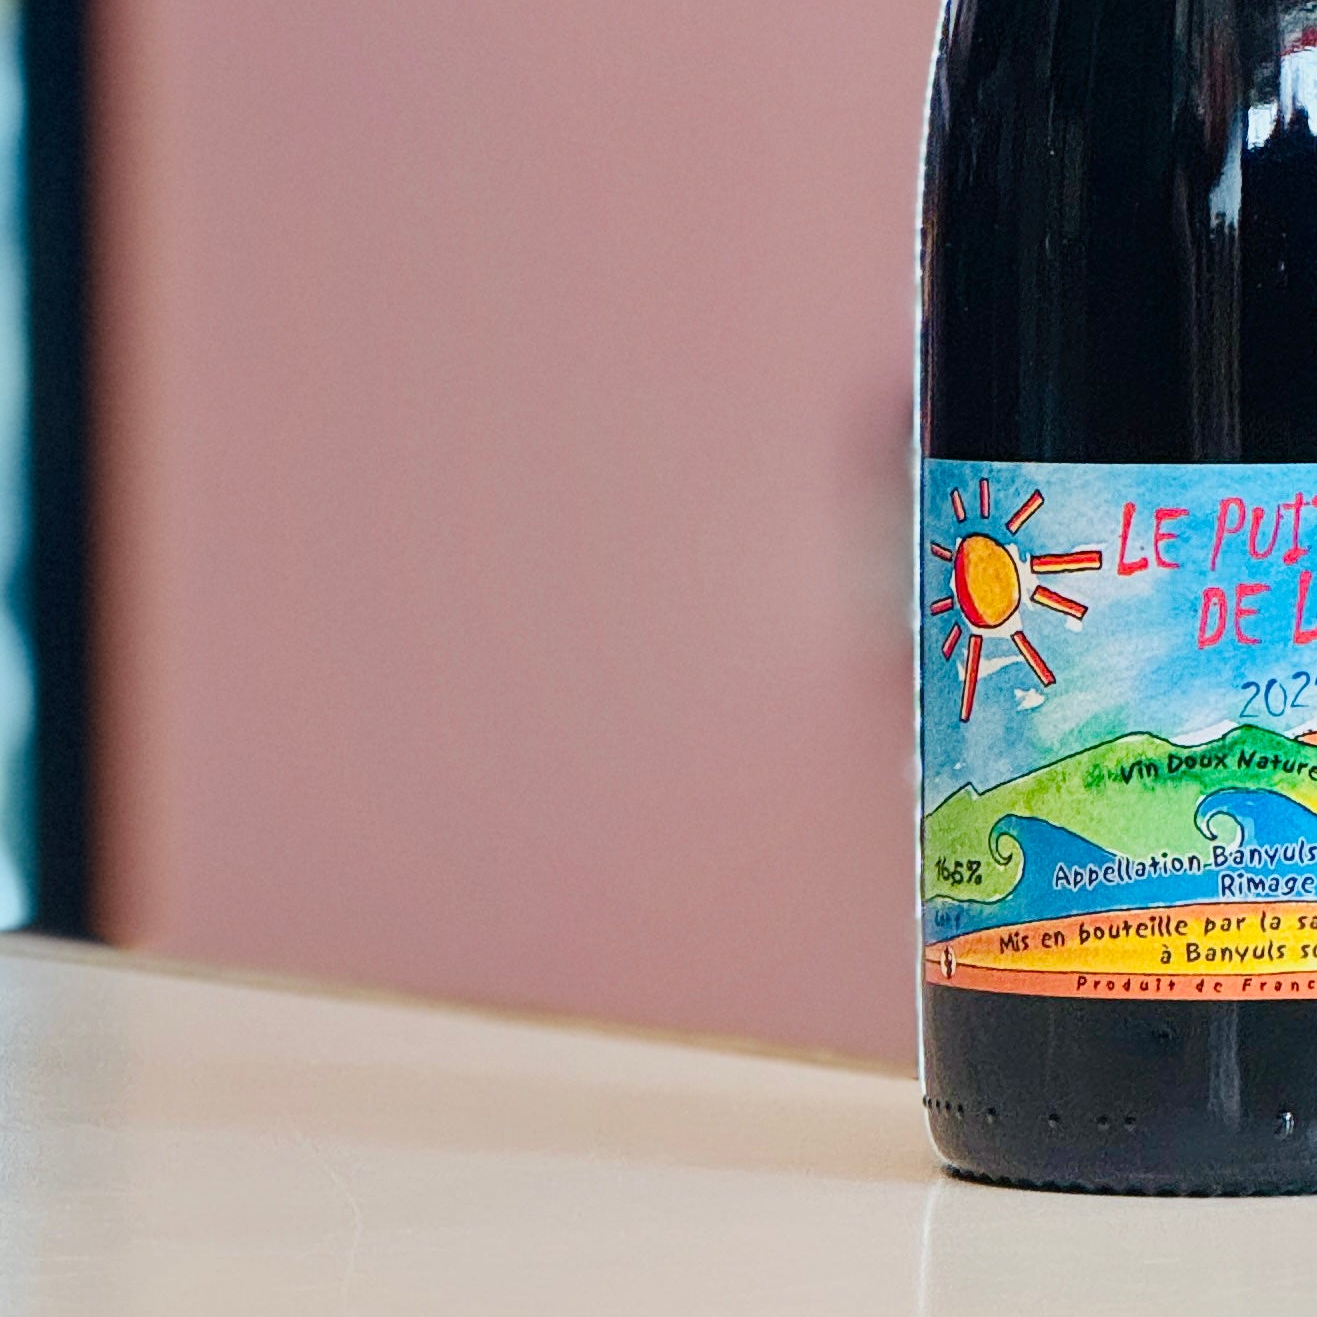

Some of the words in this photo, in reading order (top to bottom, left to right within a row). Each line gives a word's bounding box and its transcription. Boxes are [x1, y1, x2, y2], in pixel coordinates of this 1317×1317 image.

[1117, 501, 1191, 576] LE
[1197, 583, 1272, 650] DE
[1120, 760, 1160, 784] Vin
[1167, 751, 1230, 774] Doux
[1054, 852, 1202, 889] Appellation
[1212, 839, 1317, 869] Banyuls
[1221, 873, 1316, 898] Rimage
[1000, 933, 1030, 952] Mis
[1041, 929, 1065, 948] en
[1078, 916, 1189, 945] bouteille
[1203, 918, 1246, 939] par
[1259, 910, 1282, 933] la
[1159, 944, 1173, 966] à
[1185, 940, 1285, 965] Banyuls
[1076, 974, 1177, 993] Produit
[1195, 977, 1223, 994] de
